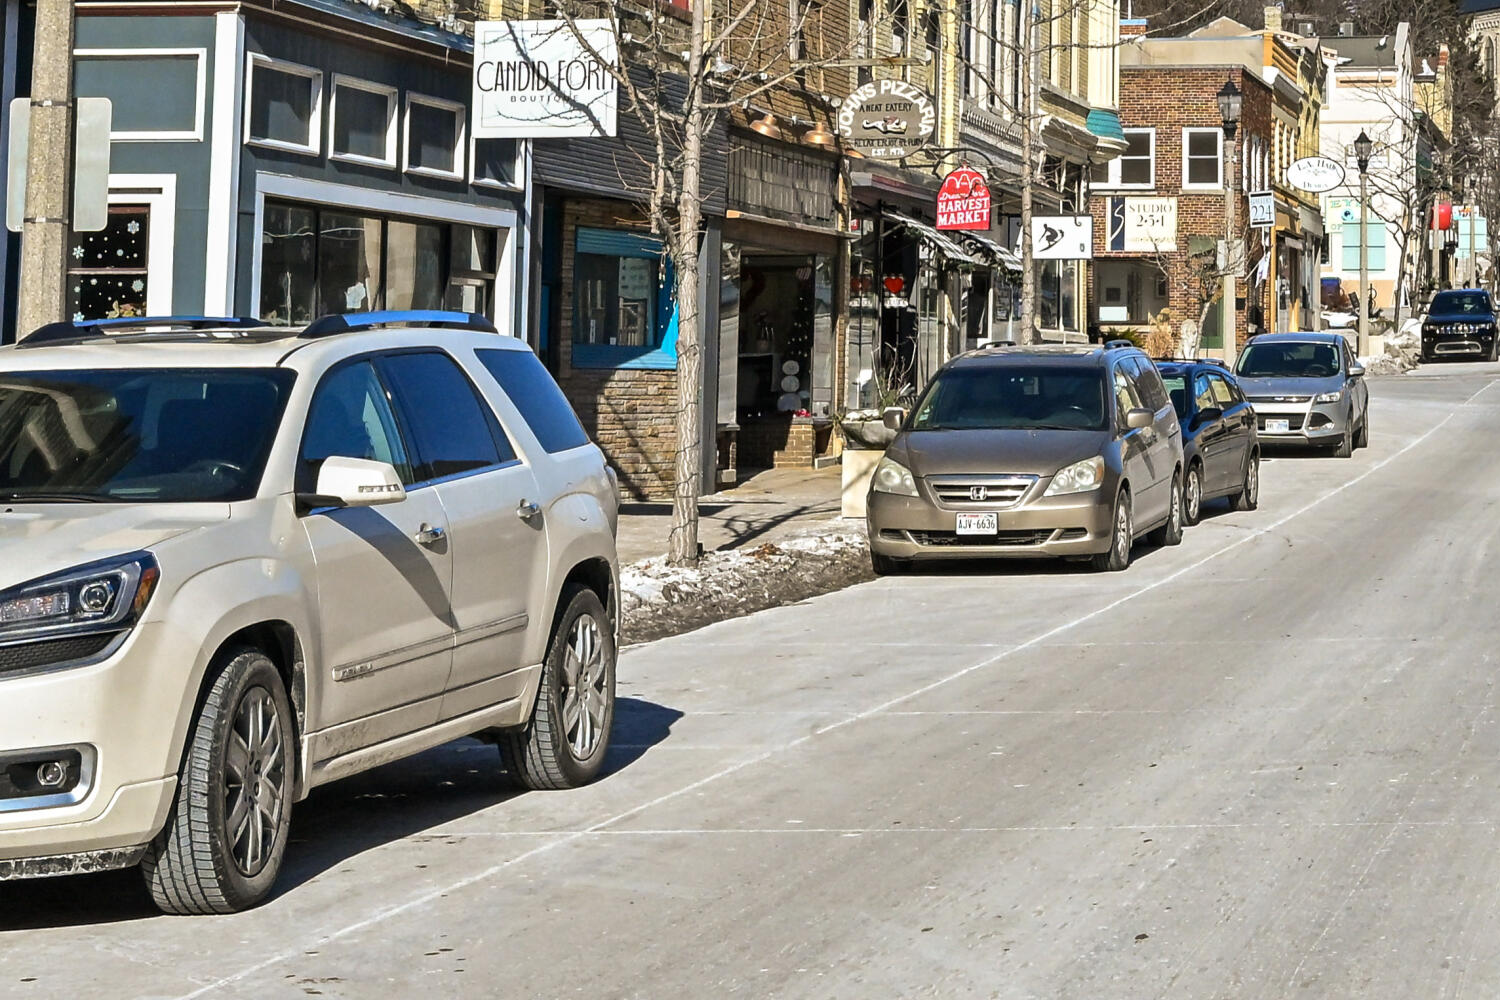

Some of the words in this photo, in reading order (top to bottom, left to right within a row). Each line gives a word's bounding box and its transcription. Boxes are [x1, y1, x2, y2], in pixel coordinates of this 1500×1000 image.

[476, 60, 549, 92] CANDID
[938, 197, 991, 213] HARVEST
[1129, 203, 1172, 214] STUDIO
[1250, 205, 1273, 222] 224
[938, 209, 990, 227] MARKET
